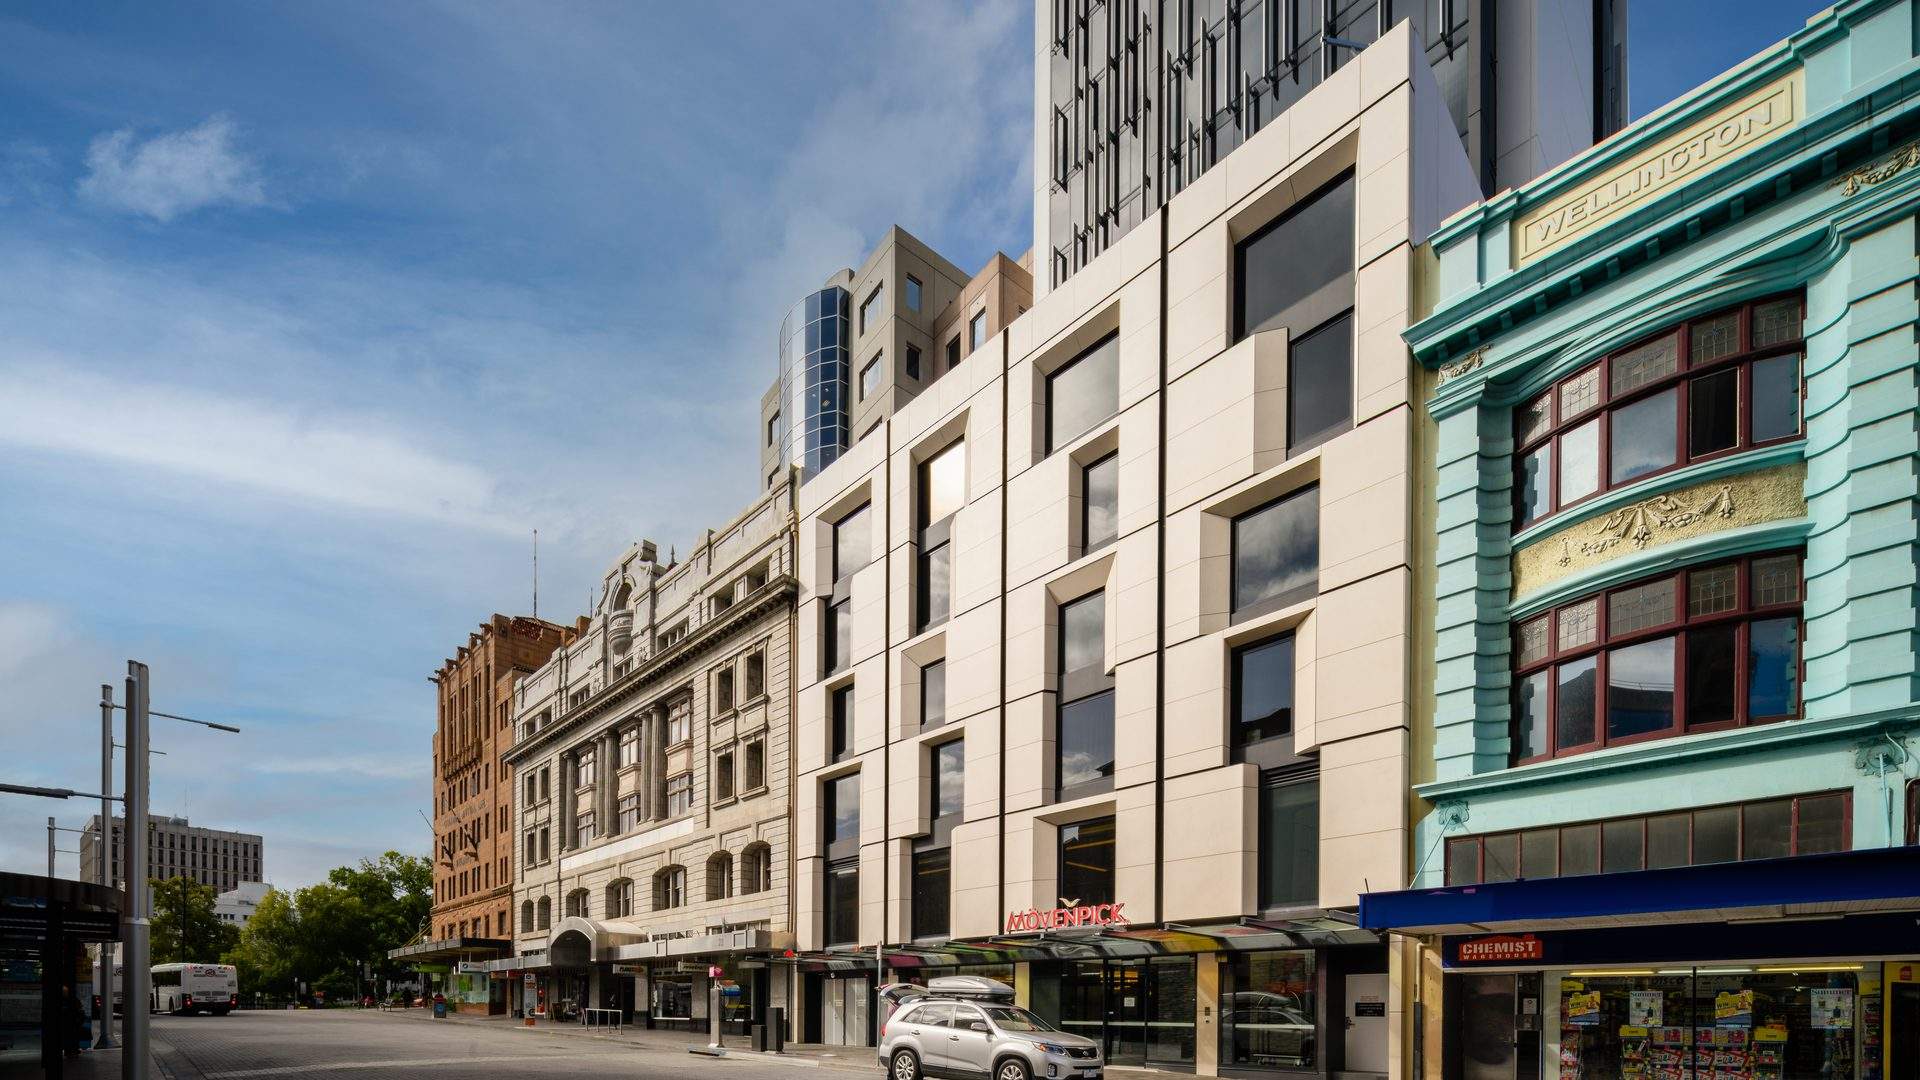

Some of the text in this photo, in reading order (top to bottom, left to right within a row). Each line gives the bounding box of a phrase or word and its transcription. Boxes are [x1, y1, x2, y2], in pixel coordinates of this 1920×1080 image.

[1538, 101, 1773, 242] WELLINGTON
[1005, 902, 1131, 933] MÖVENPICK
[1462, 941, 1537, 954] CHEMIST
[1463, 952, 1537, 960] WAREHOUSE
